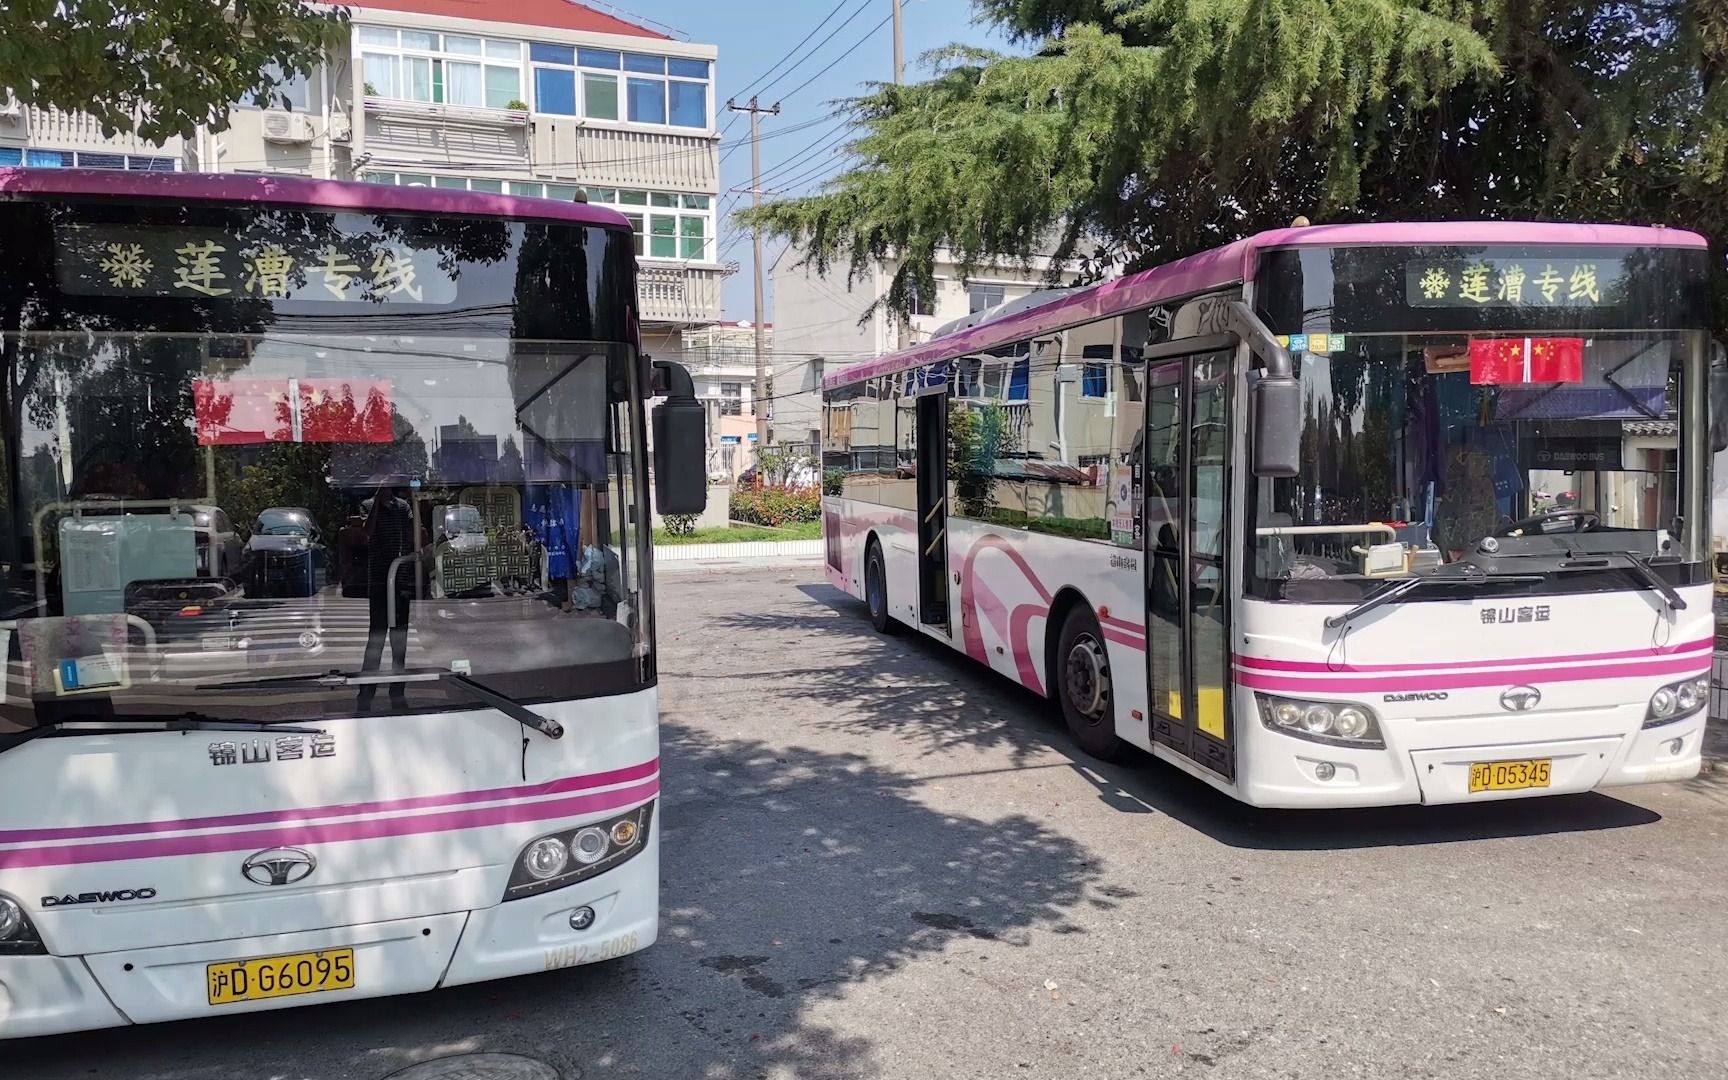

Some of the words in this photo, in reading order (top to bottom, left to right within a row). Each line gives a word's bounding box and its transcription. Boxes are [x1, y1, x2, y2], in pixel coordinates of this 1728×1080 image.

[173, 238, 423, 302] 莲漕专线
[1459, 263, 1600, 303] 莲漕专线
[1553, 452, 1588, 461] DAEWOO
[1589, 452, 1605, 460] BUS
[1383, 692, 1449, 703] DAEWOO
[208, 734, 336, 766] 锦山客运
[40, 887, 157, 907] DAEWOO
